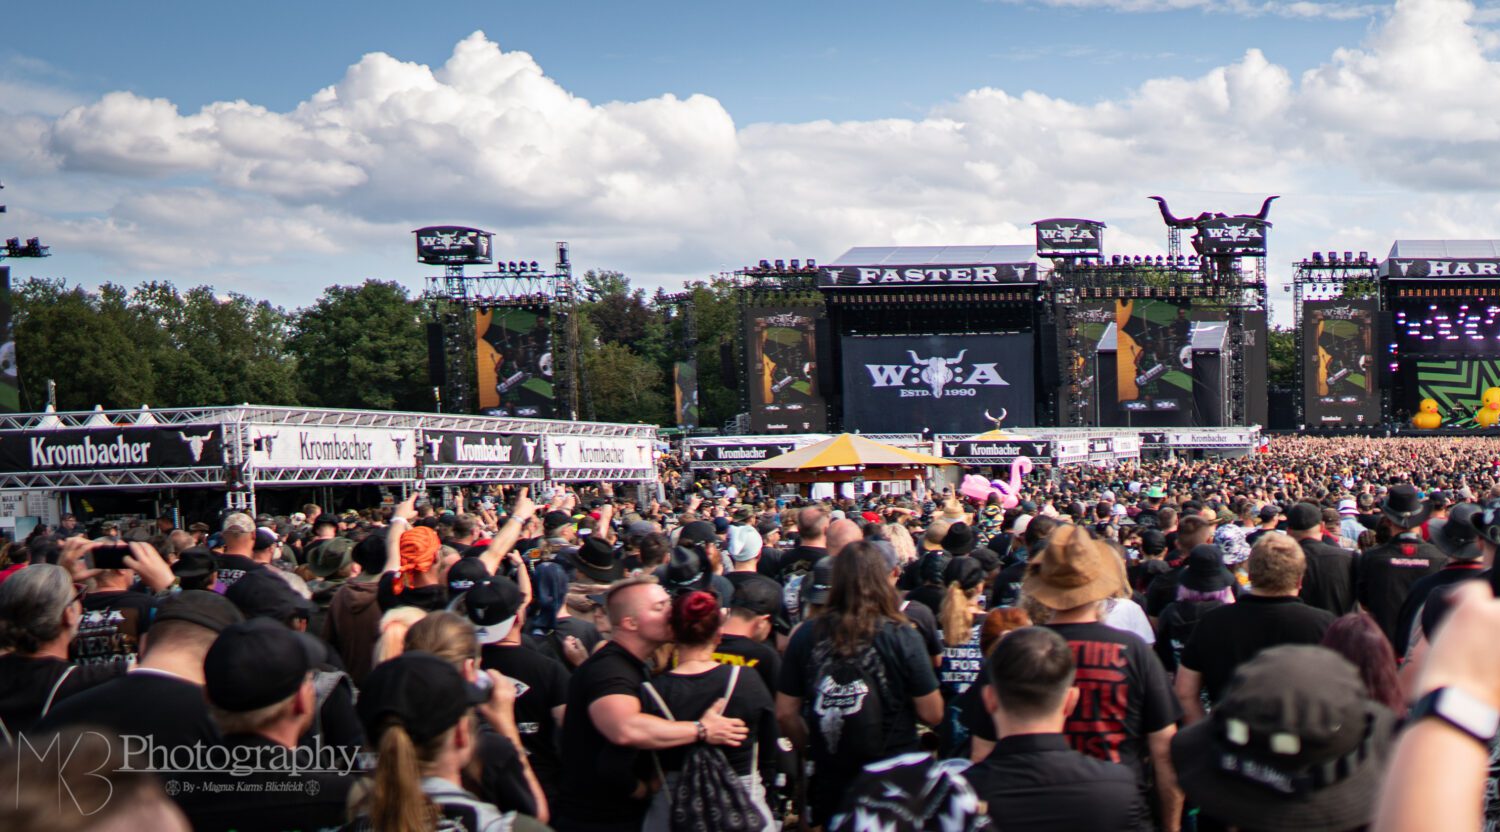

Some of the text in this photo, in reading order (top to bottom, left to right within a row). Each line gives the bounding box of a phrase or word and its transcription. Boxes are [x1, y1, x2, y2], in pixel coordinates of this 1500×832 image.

[857, 266, 999, 284] FASTER
[900, 388, 976, 397] ESTD. 1990
[300, 431, 373, 461] Krombacher
[1191, 433, 1227, 443] Krombacher
[30, 434, 151, 467] Krombacher
[455, 436, 512, 462] Krombacher
[579, 440, 625, 463] Krombacher
[717, 446, 767, 460] Krombacher
[971, 442, 1021, 456] Krombacher
[950, 659, 980, 671] FOR
